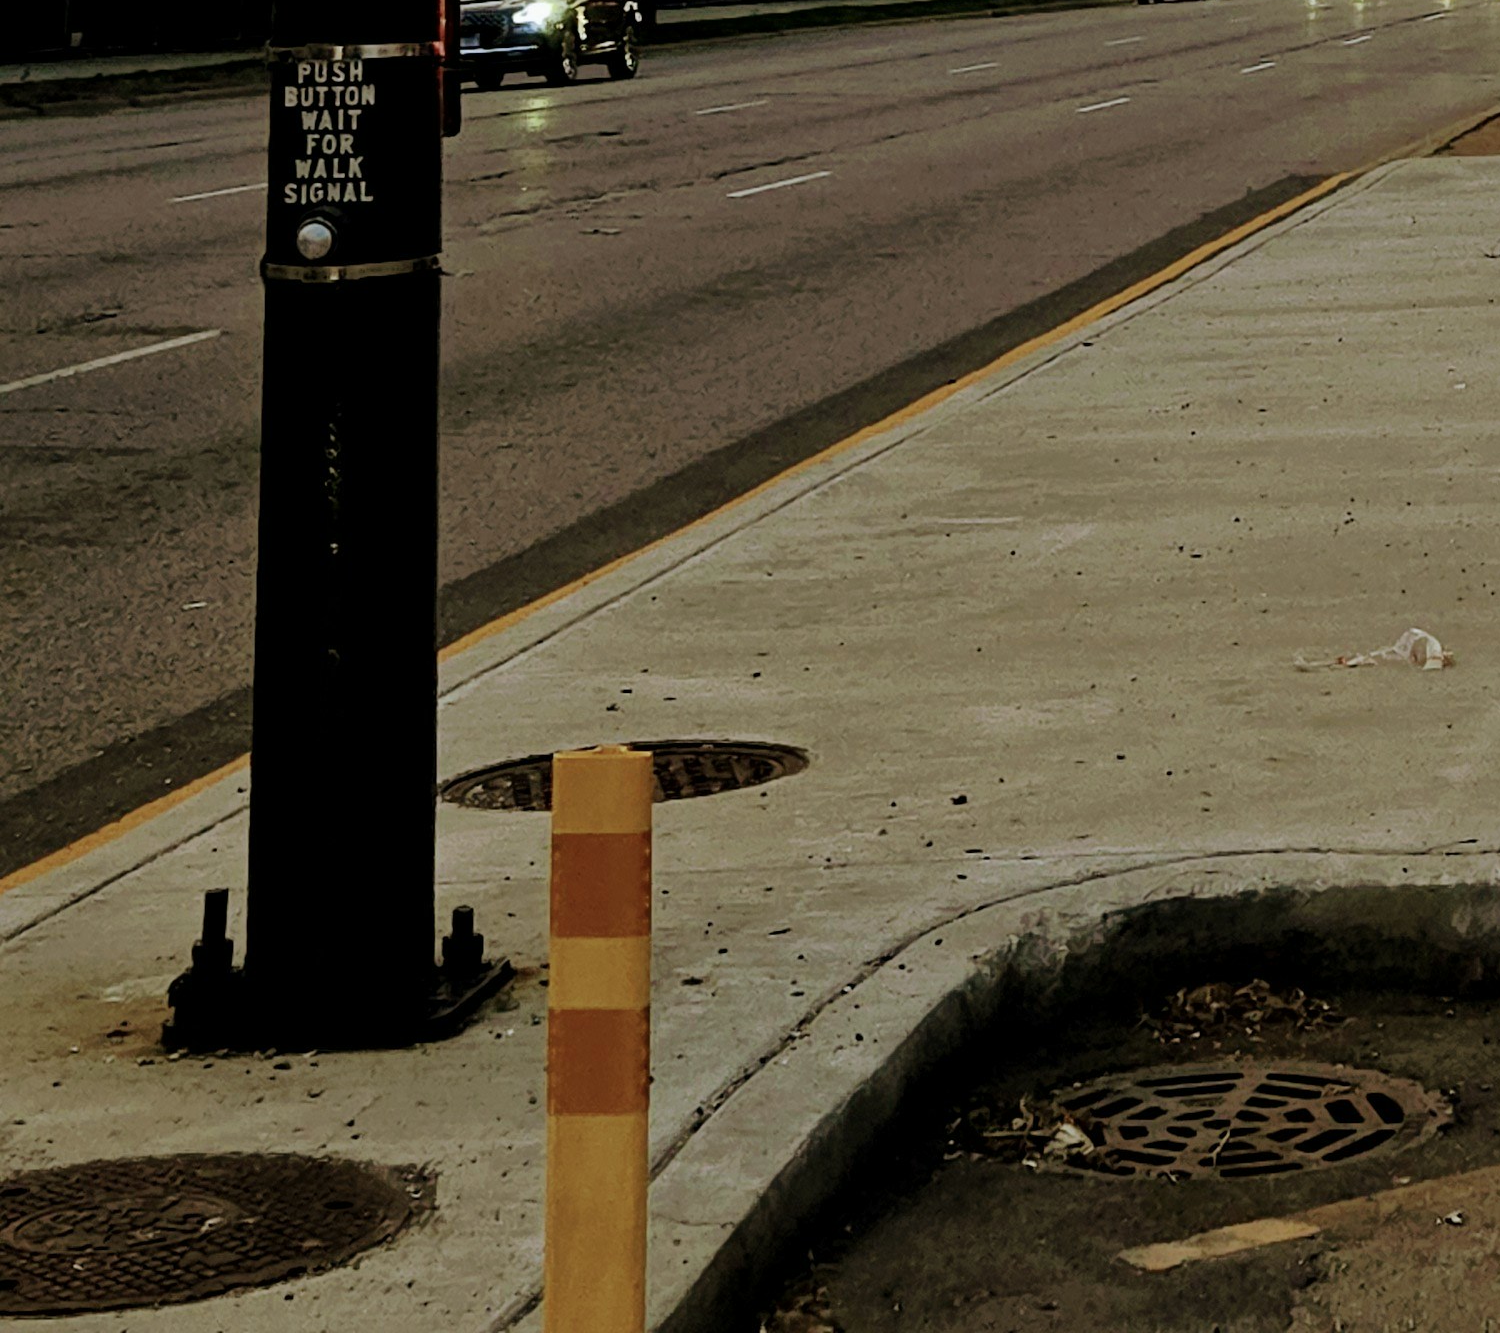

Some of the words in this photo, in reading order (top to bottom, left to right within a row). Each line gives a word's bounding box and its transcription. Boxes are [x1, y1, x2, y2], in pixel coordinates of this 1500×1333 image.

[298, 61, 363, 84] PUSH
[284, 84, 376, 107] BUTTON
[301, 108, 362, 131] WAIT
[306, 133, 354, 155] FOR
[295, 156, 364, 179] WALK
[284, 181, 374, 205] SIGNAL
